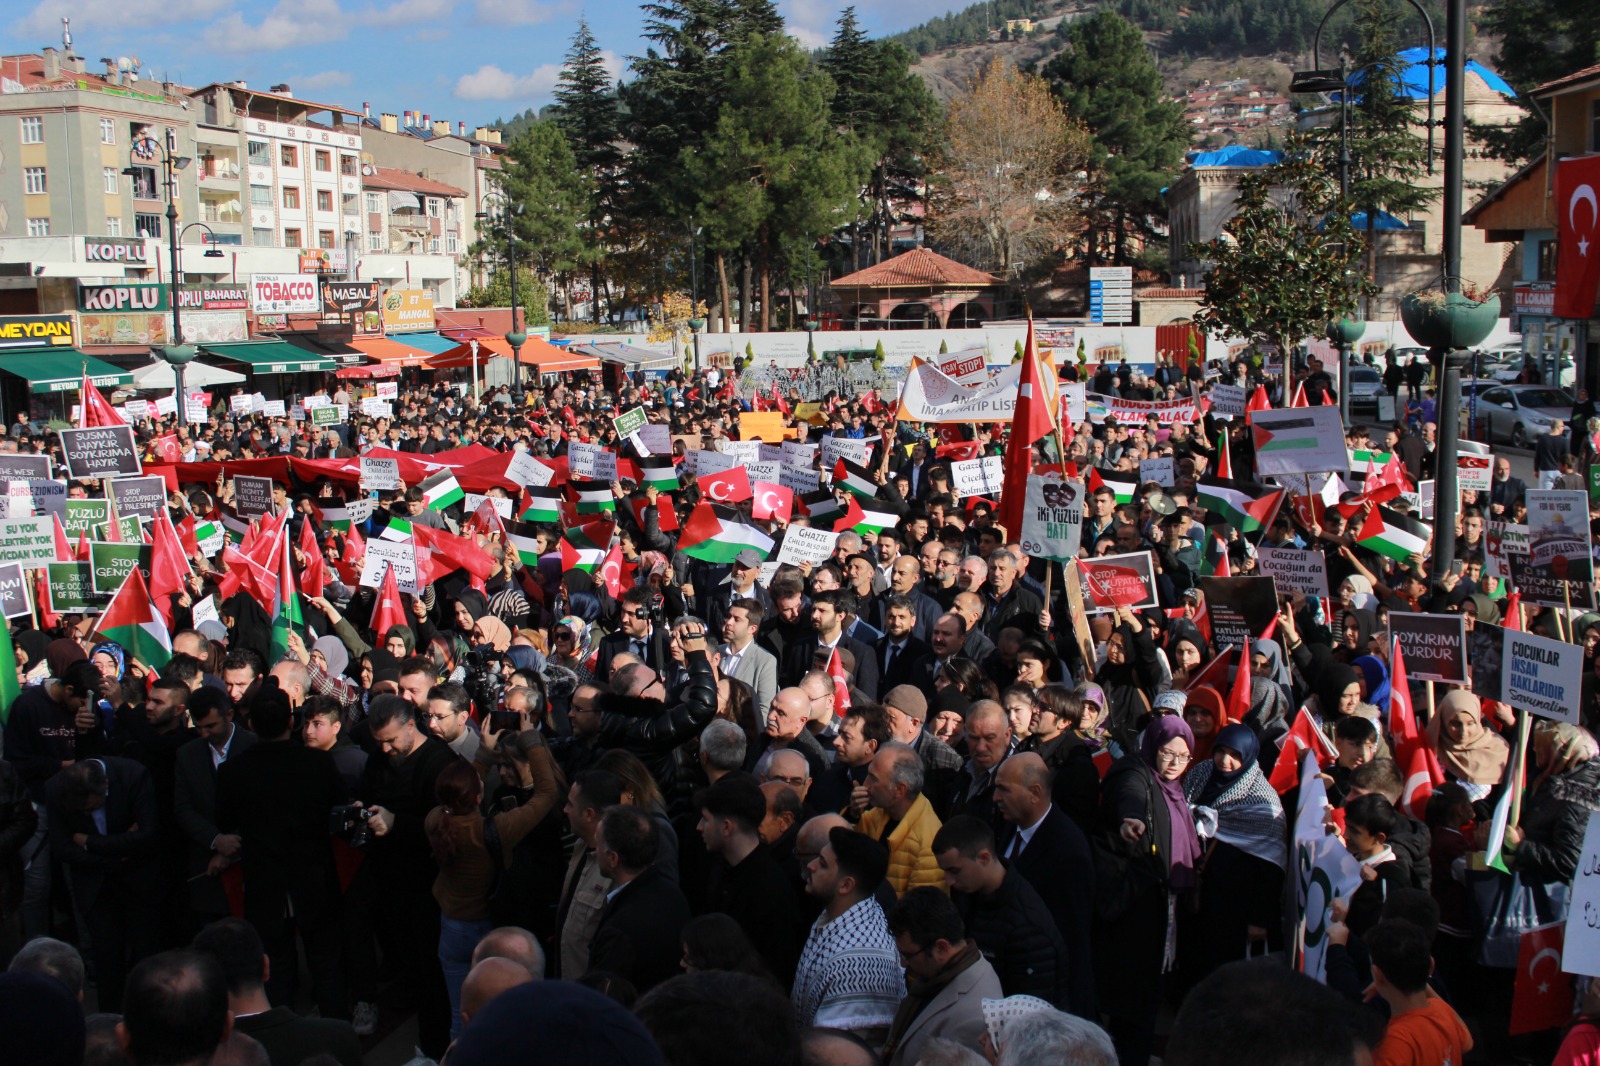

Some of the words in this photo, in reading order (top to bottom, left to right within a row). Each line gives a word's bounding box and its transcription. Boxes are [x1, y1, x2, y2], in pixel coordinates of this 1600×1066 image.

[86, 244, 147, 261] KOPLU
[203, 289, 248, 300] BAHARAT
[255, 282, 314, 301] TOBACCO
[333, 287, 371, 300] MASAL
[85, 287, 159, 310] KOPLU
[410, 296, 419, 304] ET
[1525, 293, 1555, 305] LOKANT
[399, 310, 431, 319] MANGAL
[0, 321, 71, 338] MEYDAN
[958, 356, 984, 375] STOP!
[50, 382, 78, 391] MEYDAN
[992, 398, 1016, 411] LİSE
[76, 430, 117, 440] SUSMA
[77, 440, 120, 449] HAYKIR
[69, 448, 132, 460] SOYKIRIMA
[85, 458, 119, 468] HAYIR
[365, 458, 393, 468] Ghazze
[958, 461, 982, 472] Gazze
[15, 468, 35, 476] WEST
[782, 464, 794, 474] Why
[805, 471, 816, 479] you
[780, 473, 793, 484] illing
[11, 486, 33, 497] CURSE
[35, 485, 65, 495] ZIONISM
[242, 487, 264, 495] DIGNITY
[124, 494, 163, 503] OCCUPATION
[125, 502, 159, 511] PALESTINE
[69, 508, 105, 519] YÜZLÜ
[1052, 507, 1079, 525] YÜZLÜ
[6, 524, 18, 535] SU
[19, 523, 38, 533] YOK
[66, 519, 89, 530] BATI
[799, 529, 828, 543] GHAZZE
[1047, 523, 1068, 540] BATI
[34, 535, 52, 544] YOK
[788, 537, 805, 546] CHILD
[807, 543, 820, 551] ALSO
[367, 546, 399, 559] Çocuklar
[782, 545, 793, 553] THE
[794, 548, 811, 557] RIGHT
[1271, 549, 1307, 562] Gazzeli
[112, 558, 139, 567] STOP
[381, 559, 411, 574] Dnya
[1263, 560, 1305, 573] Çocuğun
[1308, 564, 1322, 573] da
[70, 574, 86, 582] STOP
[1095, 569, 1117, 579] STOP
[1274, 571, 1314, 584] Büyüme
[68, 582, 94, 590] OCCUP
[1301, 585, 1320, 595] Var
[58, 591, 66, 599] OF
[1520, 586, 1582, 599] YENECK
[1511, 656, 1538, 677] İNSAN
[1510, 673, 1565, 701] HAKLARIDIR
